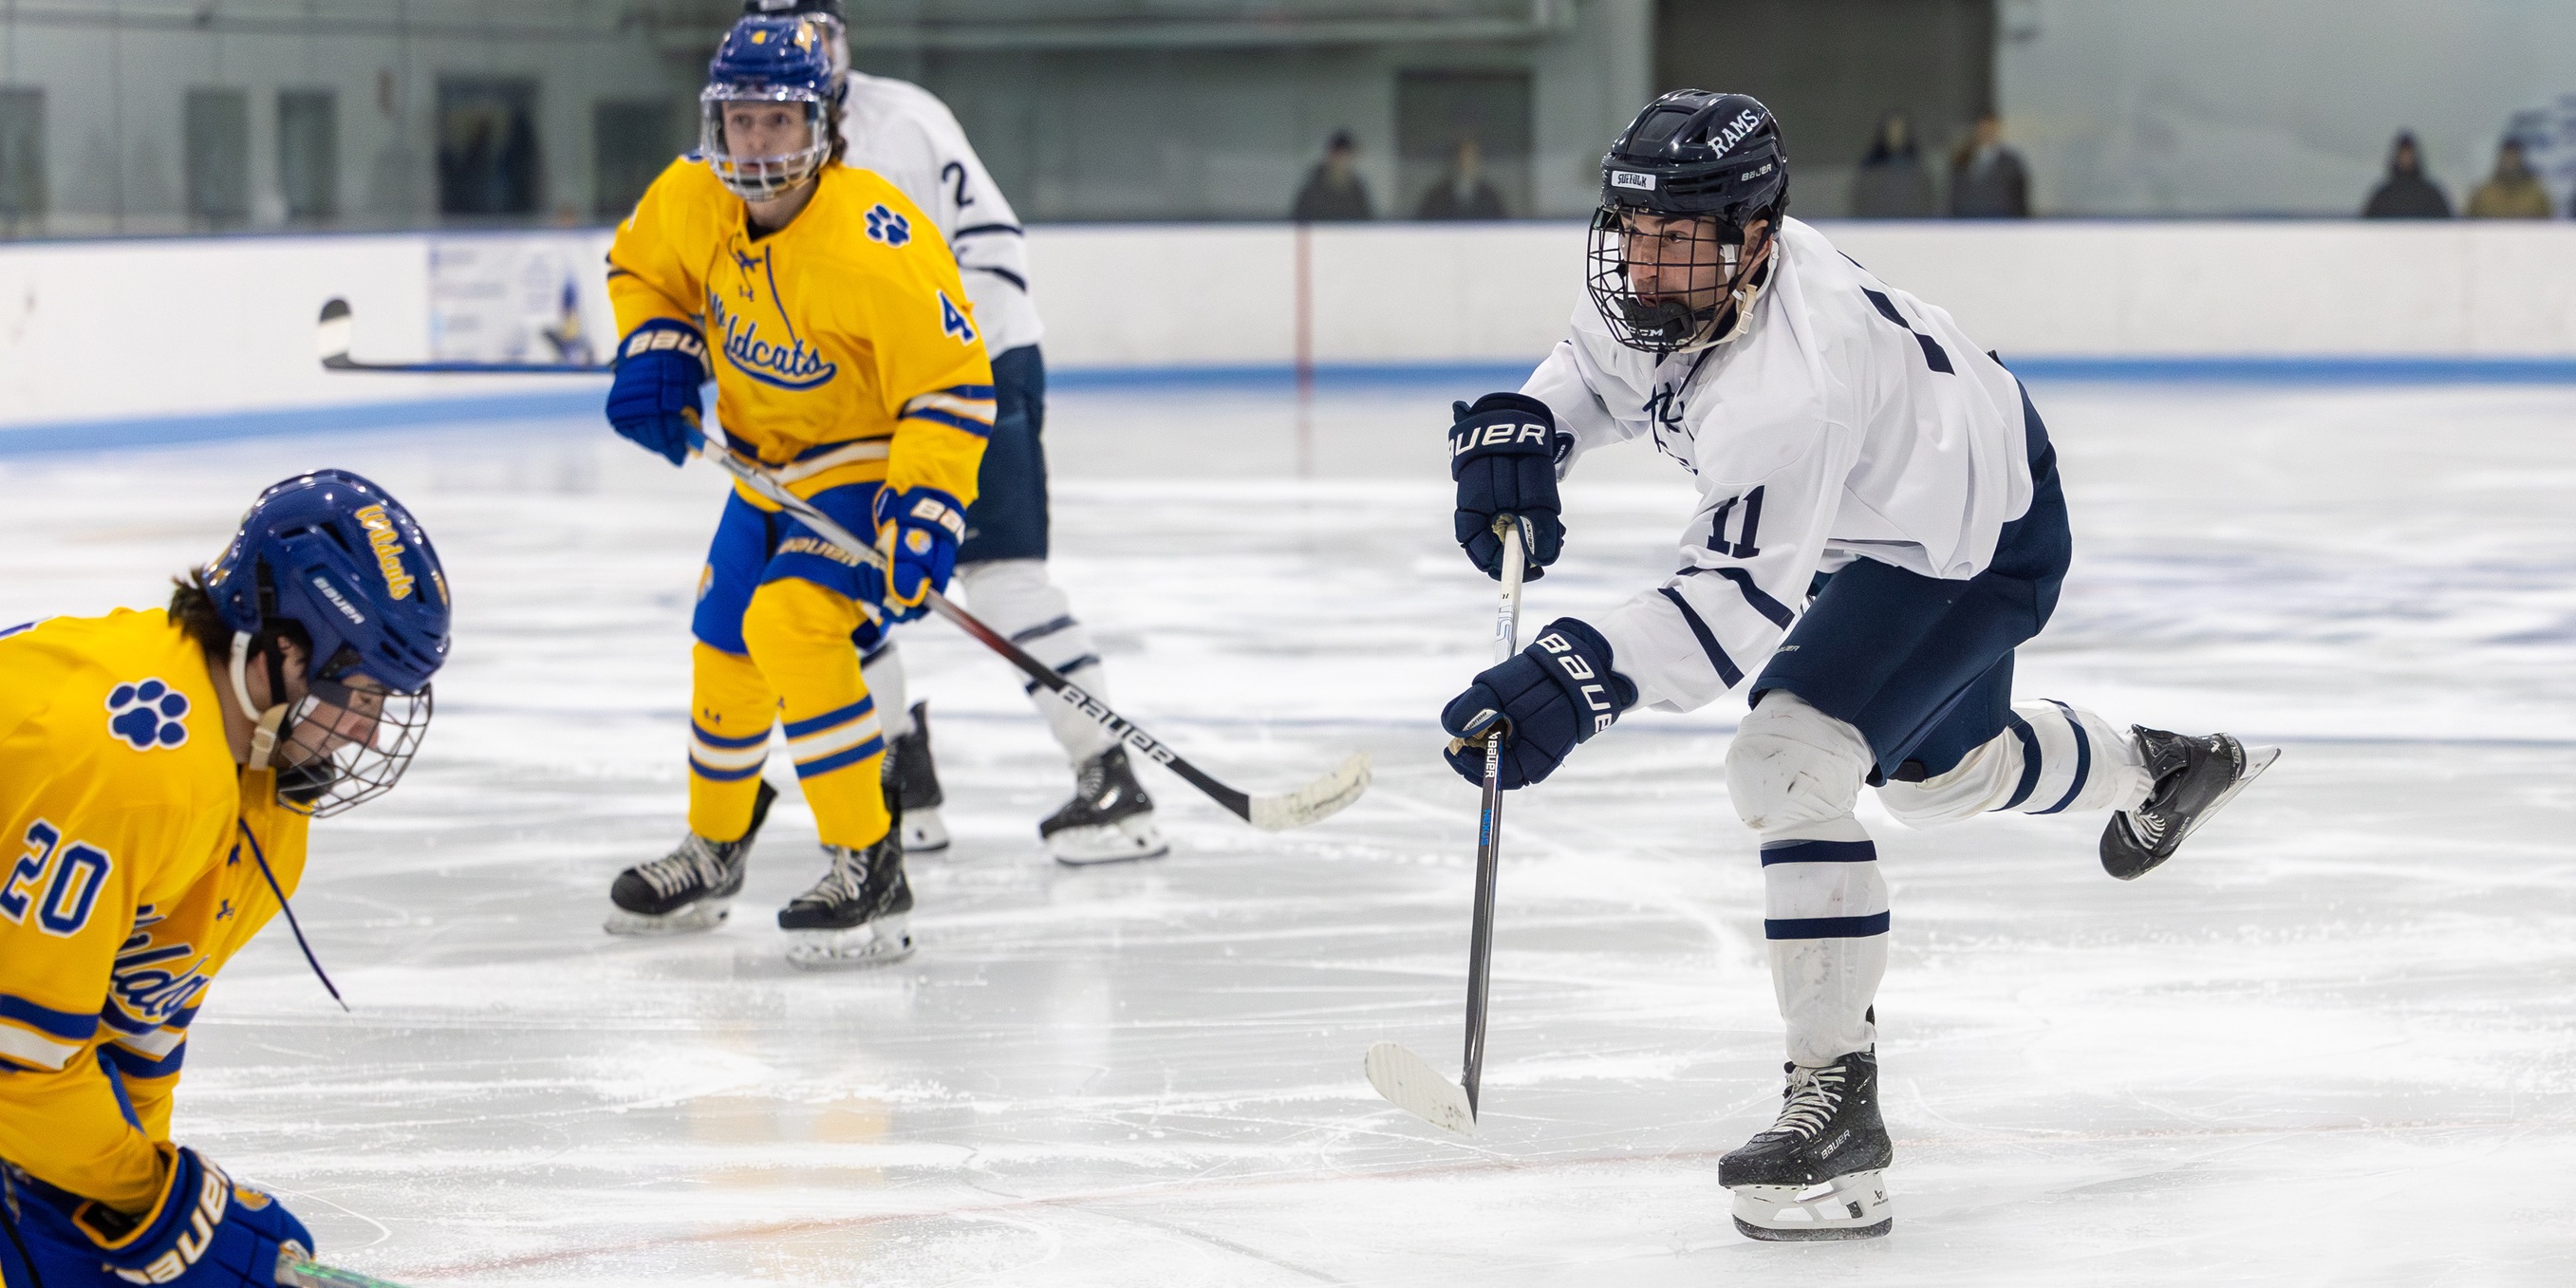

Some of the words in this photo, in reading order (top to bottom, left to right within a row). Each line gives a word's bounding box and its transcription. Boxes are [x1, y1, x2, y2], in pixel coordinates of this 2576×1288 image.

[1708, 108, 1760, 159] RAMS
[942, 161, 974, 208] 2
[1741, 163, 1773, 181] BAUER
[705, 285, 835, 383] ldcats
[937, 289, 978, 346] 4
[1707, 485, 1764, 559] 11
[353, 504, 415, 600] Wildcats
[312, 576, 365, 625] BAUER
[1057, 684, 1177, 765] BAUER
[1484, 740, 1498, 778] BAUER
[1481, 808, 1492, 846] NEXUS
[0, 817, 114, 939] 20
[1820, 1129, 1851, 1160] BAUER
